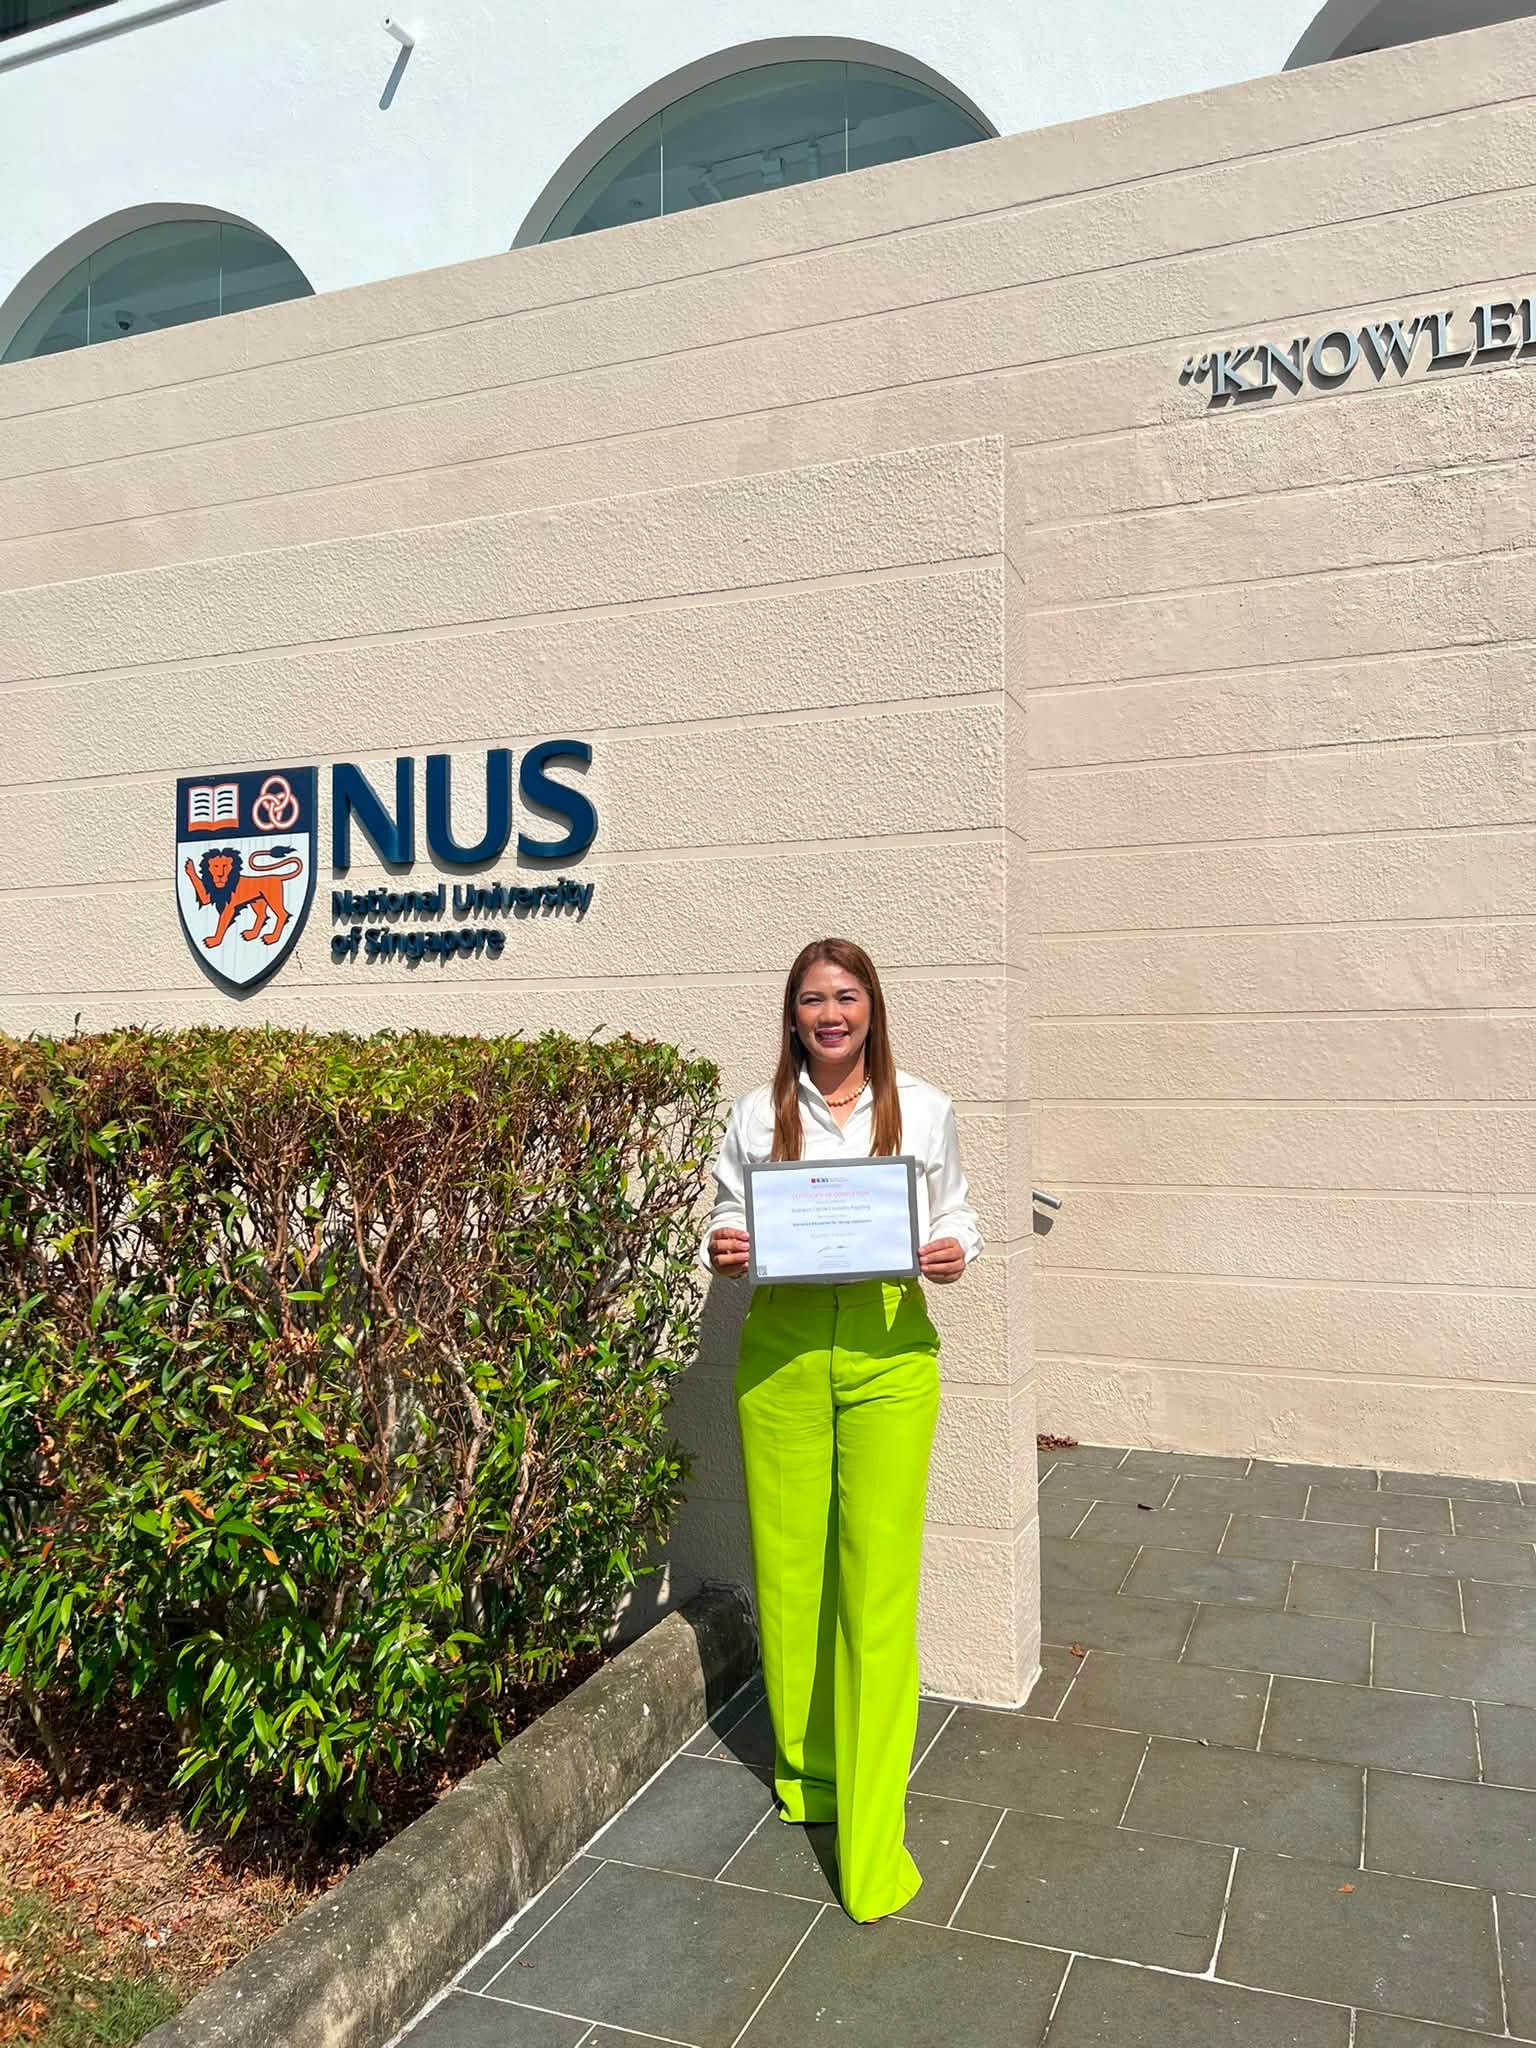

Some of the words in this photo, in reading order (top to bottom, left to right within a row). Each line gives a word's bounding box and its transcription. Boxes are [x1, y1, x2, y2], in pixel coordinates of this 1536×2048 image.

[1181, 296, 1536, 398] “KNOWLE
[332, 739, 598, 869] NUS
[332, 883, 446, 915] National
[453, 877, 594, 915] University
[331, 927, 362, 954] of
[365, 927, 506, 960] Singapore
